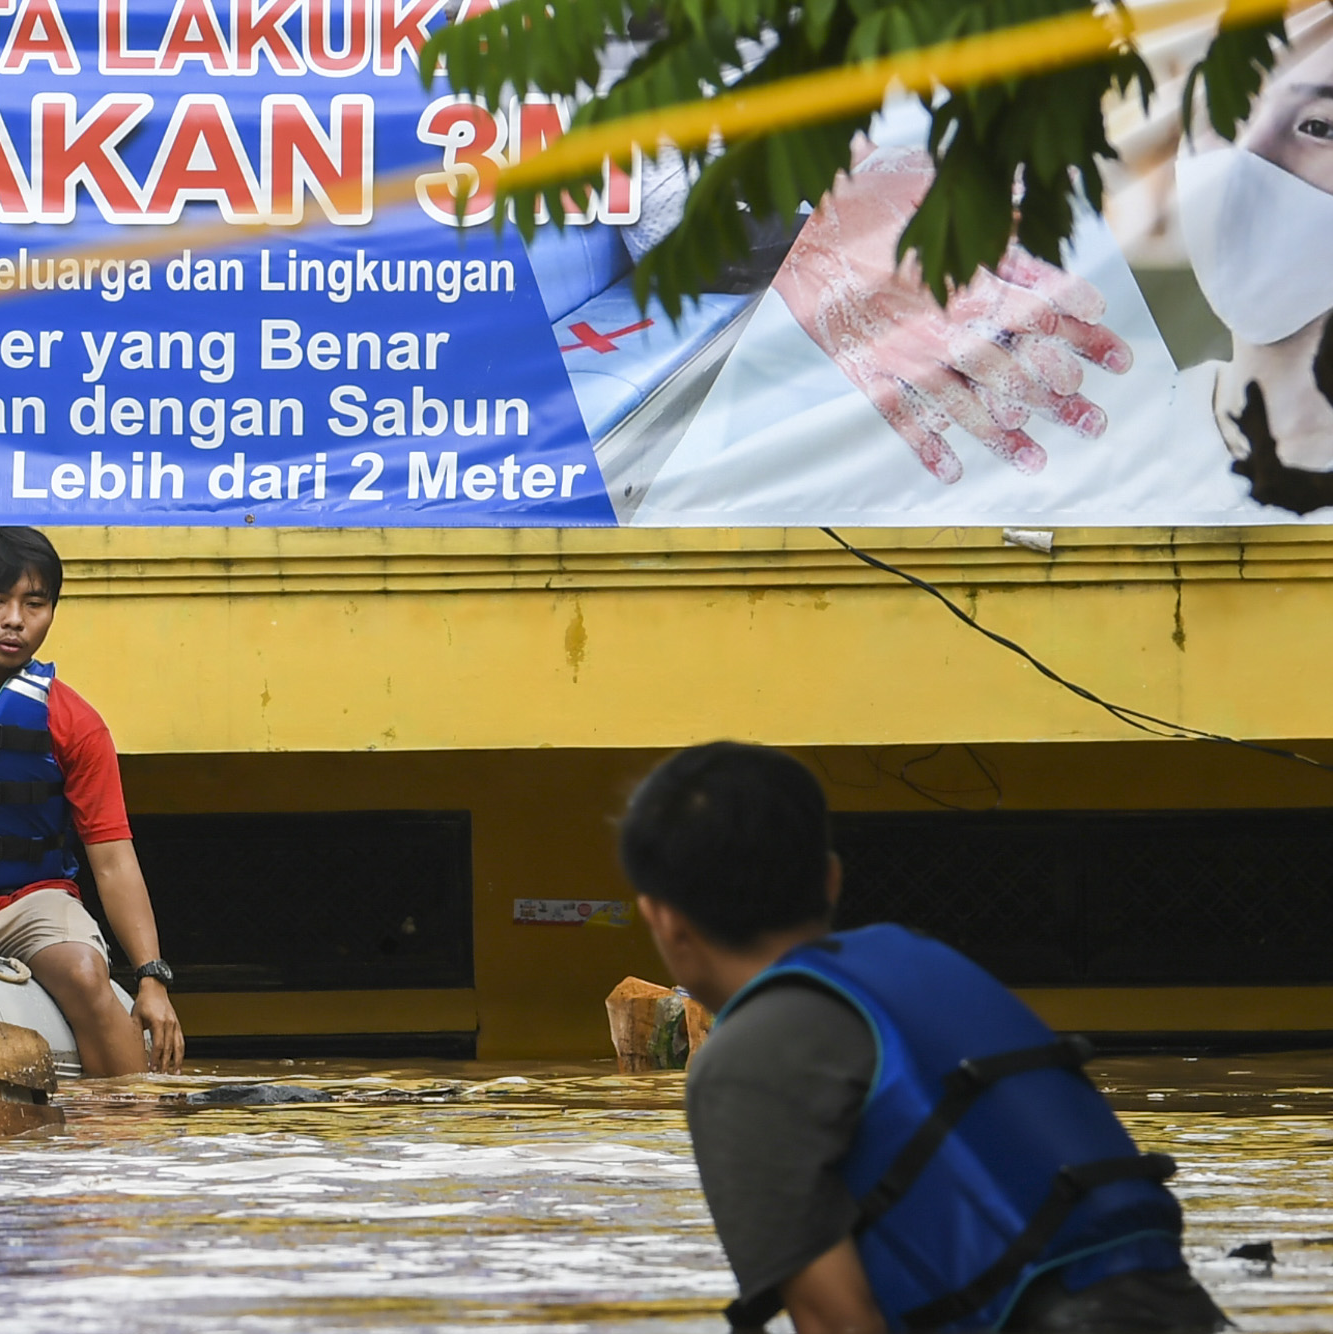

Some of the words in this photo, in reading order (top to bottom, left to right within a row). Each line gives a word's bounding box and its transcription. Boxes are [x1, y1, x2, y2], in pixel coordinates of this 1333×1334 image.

[99, 0, 503, 78] LAKUK
[165, 249, 244, 291] dan
[260, 248, 516, 303] Lingkungan
[81, 329, 236, 384] yang
[260, 318, 450, 371] Benar
[69, 385, 305, 449] dengan
[327, 385, 531, 437] Sabun
[12, 451, 186, 500] Lebih
[207, 451, 328, 500] dari
[350, 451, 386, 500] 2
[407, 450, 587, 501] Meter
